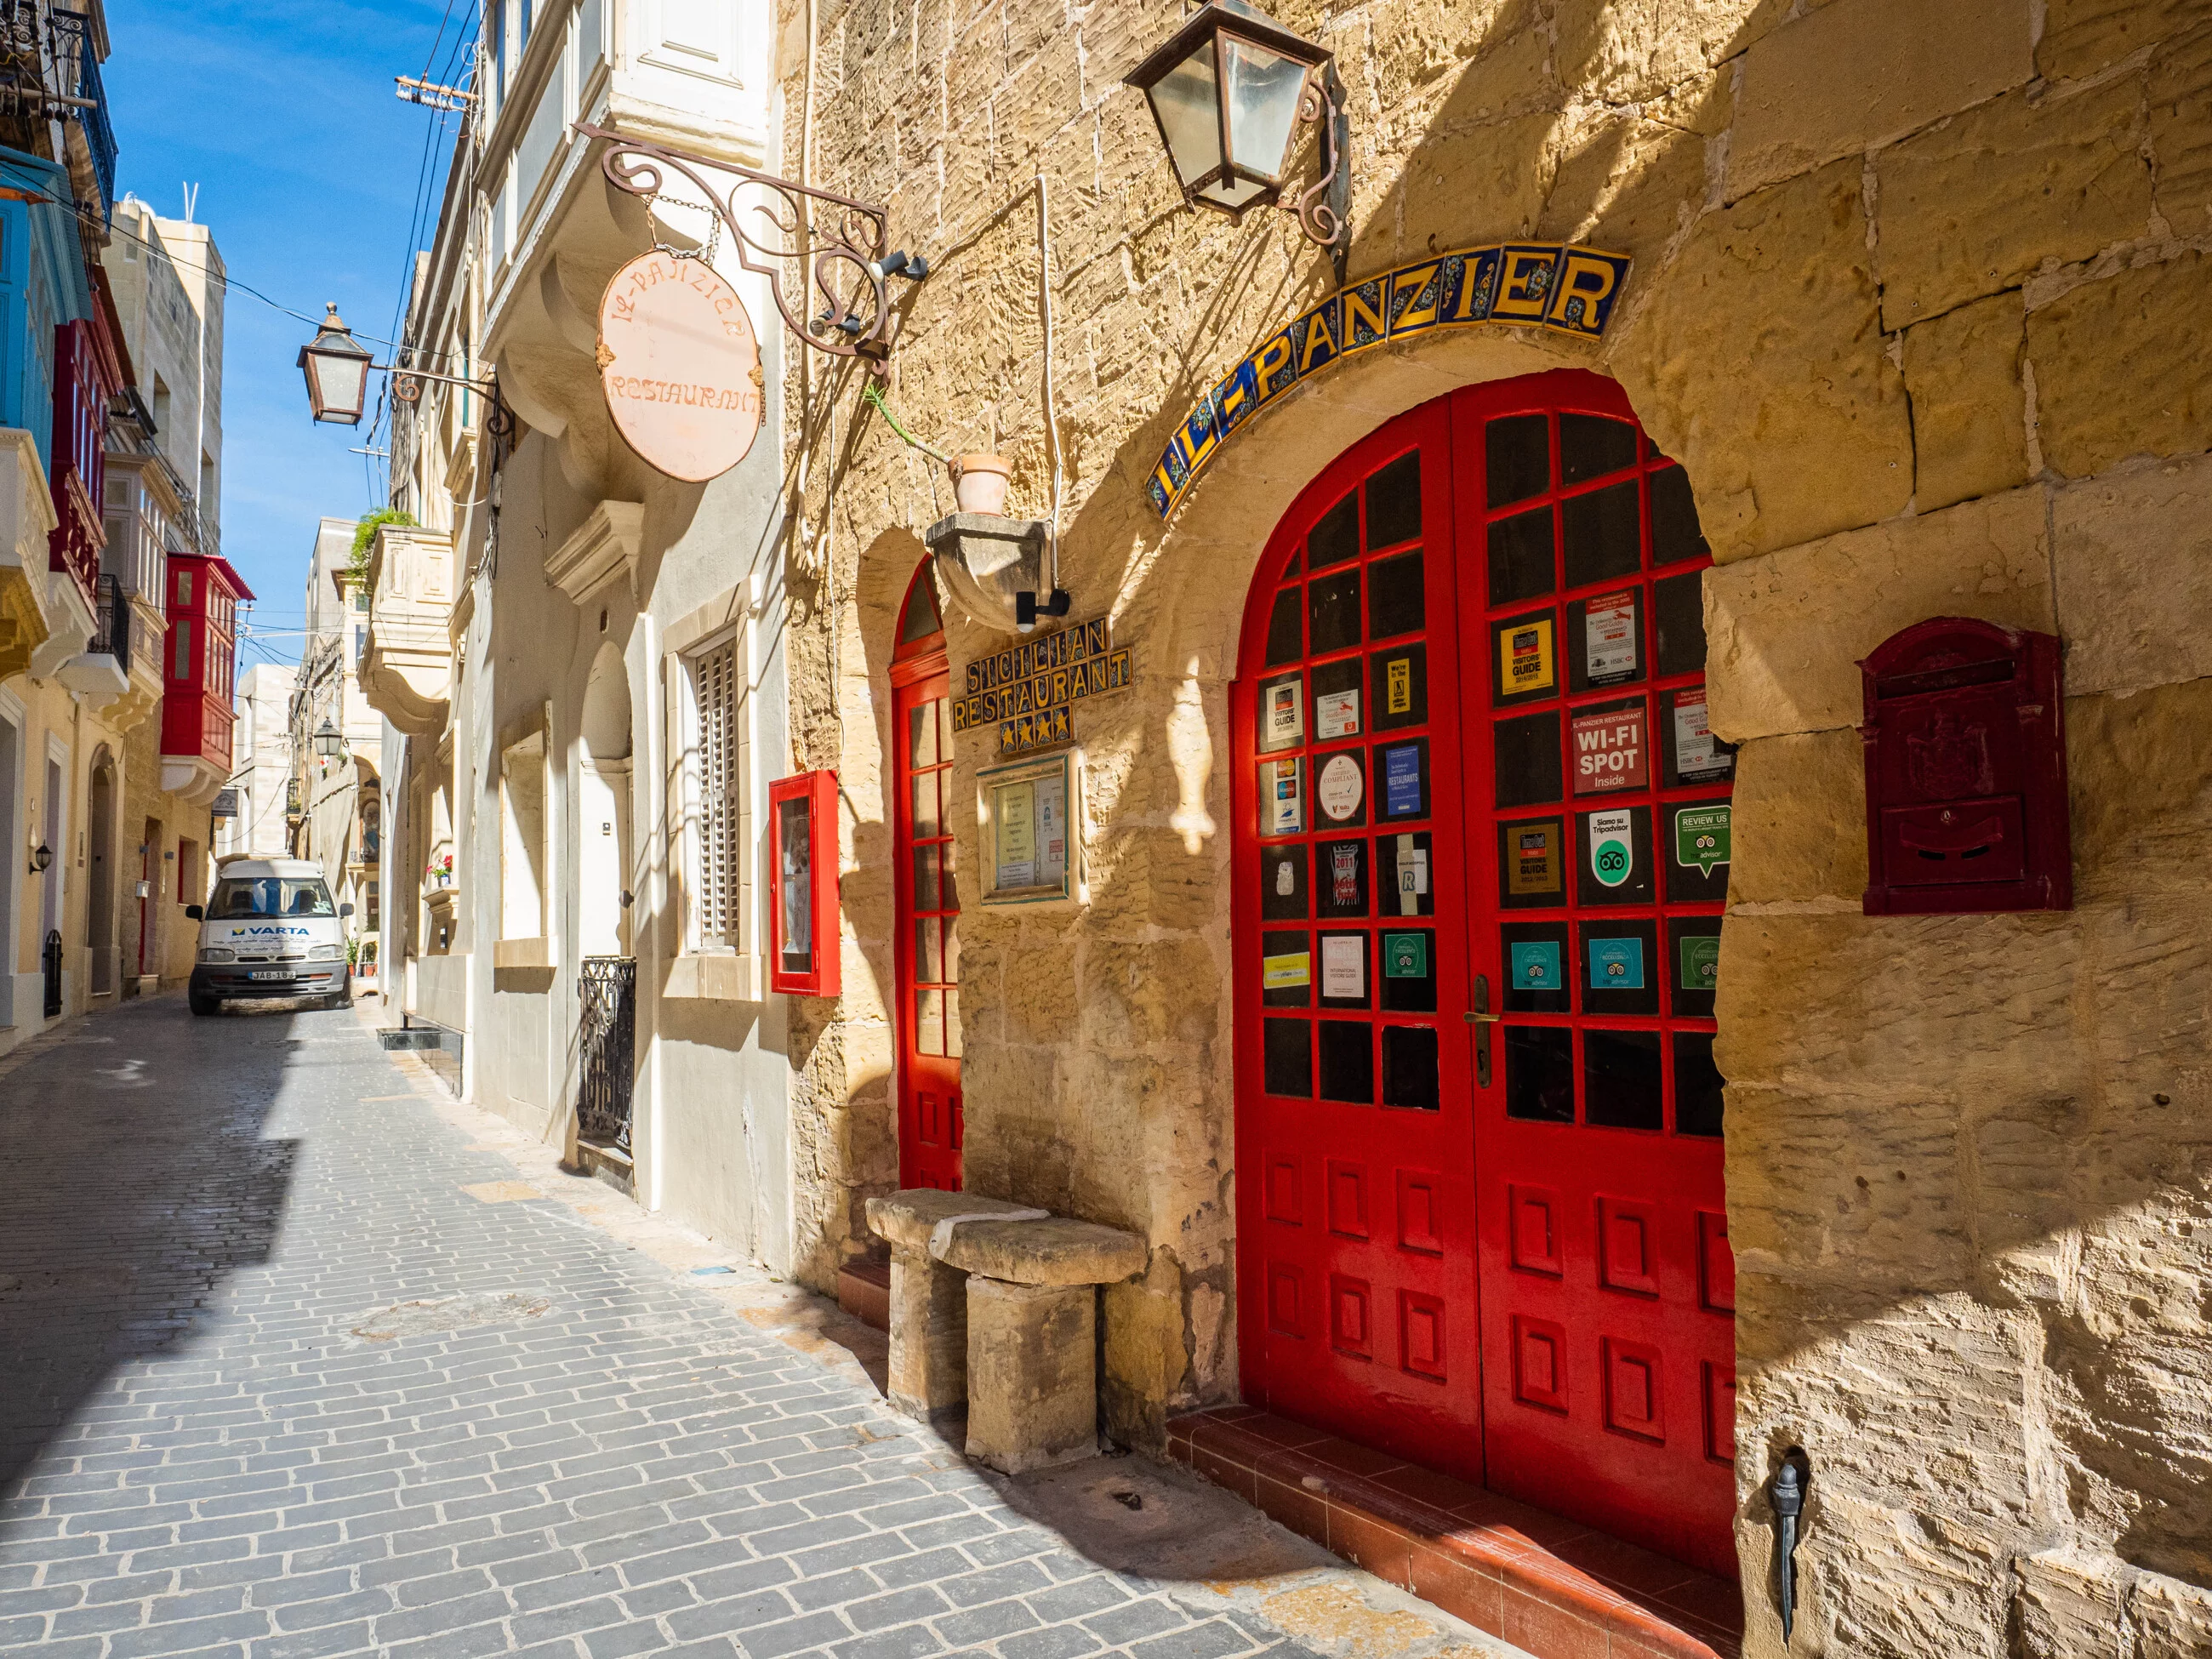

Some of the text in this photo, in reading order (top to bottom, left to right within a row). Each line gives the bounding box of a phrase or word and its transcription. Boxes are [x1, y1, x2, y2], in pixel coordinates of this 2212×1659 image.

[1157, 253, 1615, 502] IL-PANZIER
[609, 376, 759, 413] RESTAURANT
[968, 619, 1105, 692] SICILIAN
[1513, 661, 1542, 676] GUIDE
[954, 653, 1127, 730] RESTAURANT
[1275, 714, 1296, 726] GUIDE
[1573, 712, 1642, 728] IL-PANZIER RESTAURANT
[1578, 725, 1638, 751] WI-FI
[1580, 749, 1638, 775] SPOT
[1324, 774, 1357, 784] COMPLIANT
[1388, 772, 1418, 786] RESTAURANTS
[1595, 775, 1625, 787] Inside
[1682, 814, 1728, 826] REVIEW US
[1593, 824, 1628, 834] Tripadvisor
[1336, 857, 1354, 869] 2011
[1520, 864, 1548, 875] GUIDE
[1403, 870, 1415, 892] R
